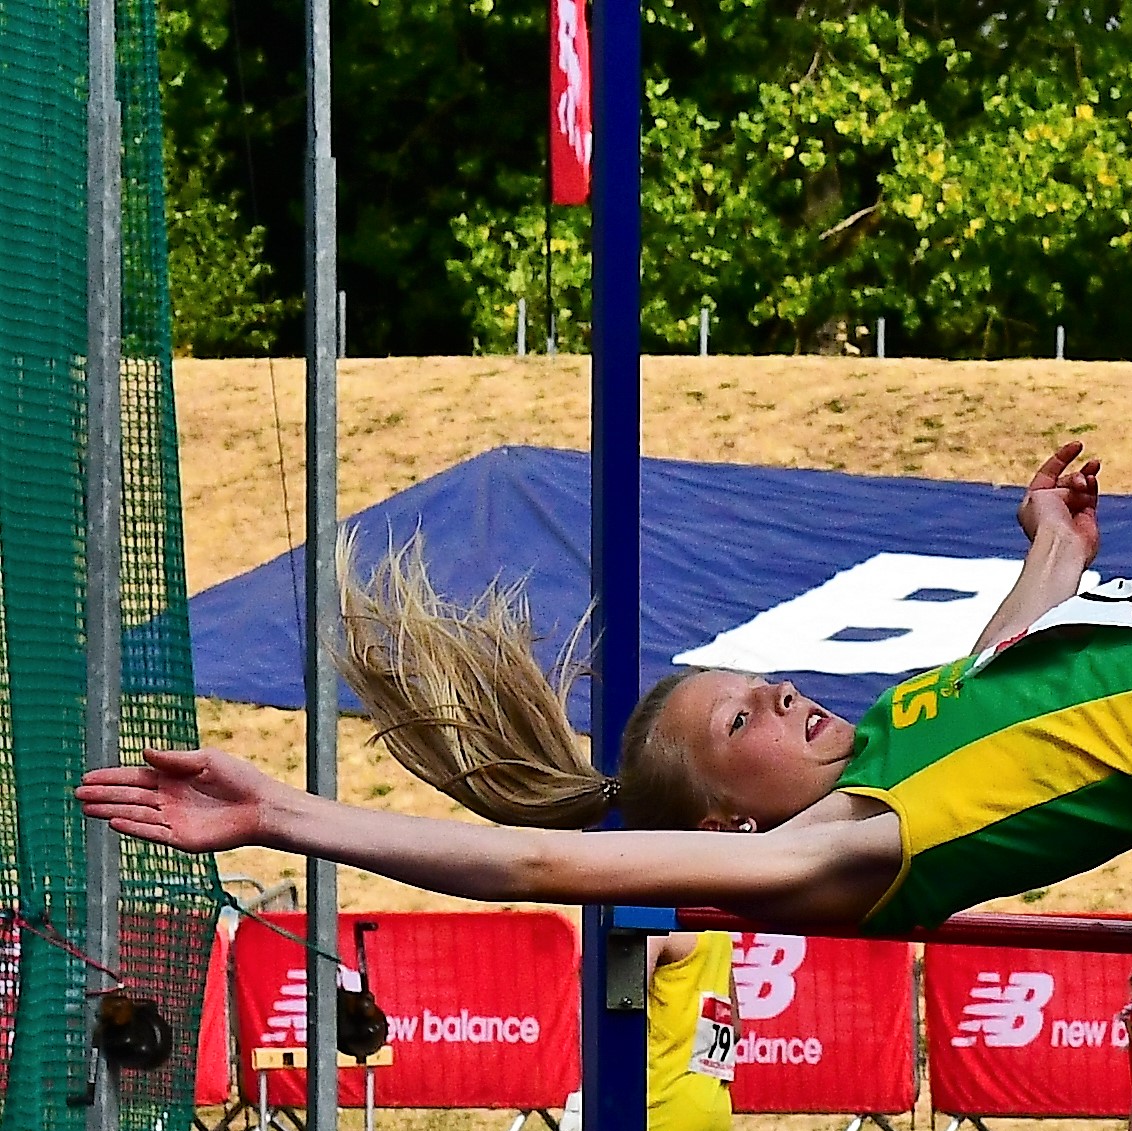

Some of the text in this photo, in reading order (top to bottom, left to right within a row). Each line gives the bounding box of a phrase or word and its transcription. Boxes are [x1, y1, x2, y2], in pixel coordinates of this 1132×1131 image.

[423, 1008, 540, 1044] balance
[1050, 1018, 1107, 1048] new
[735, 1030, 823, 1065] alance
